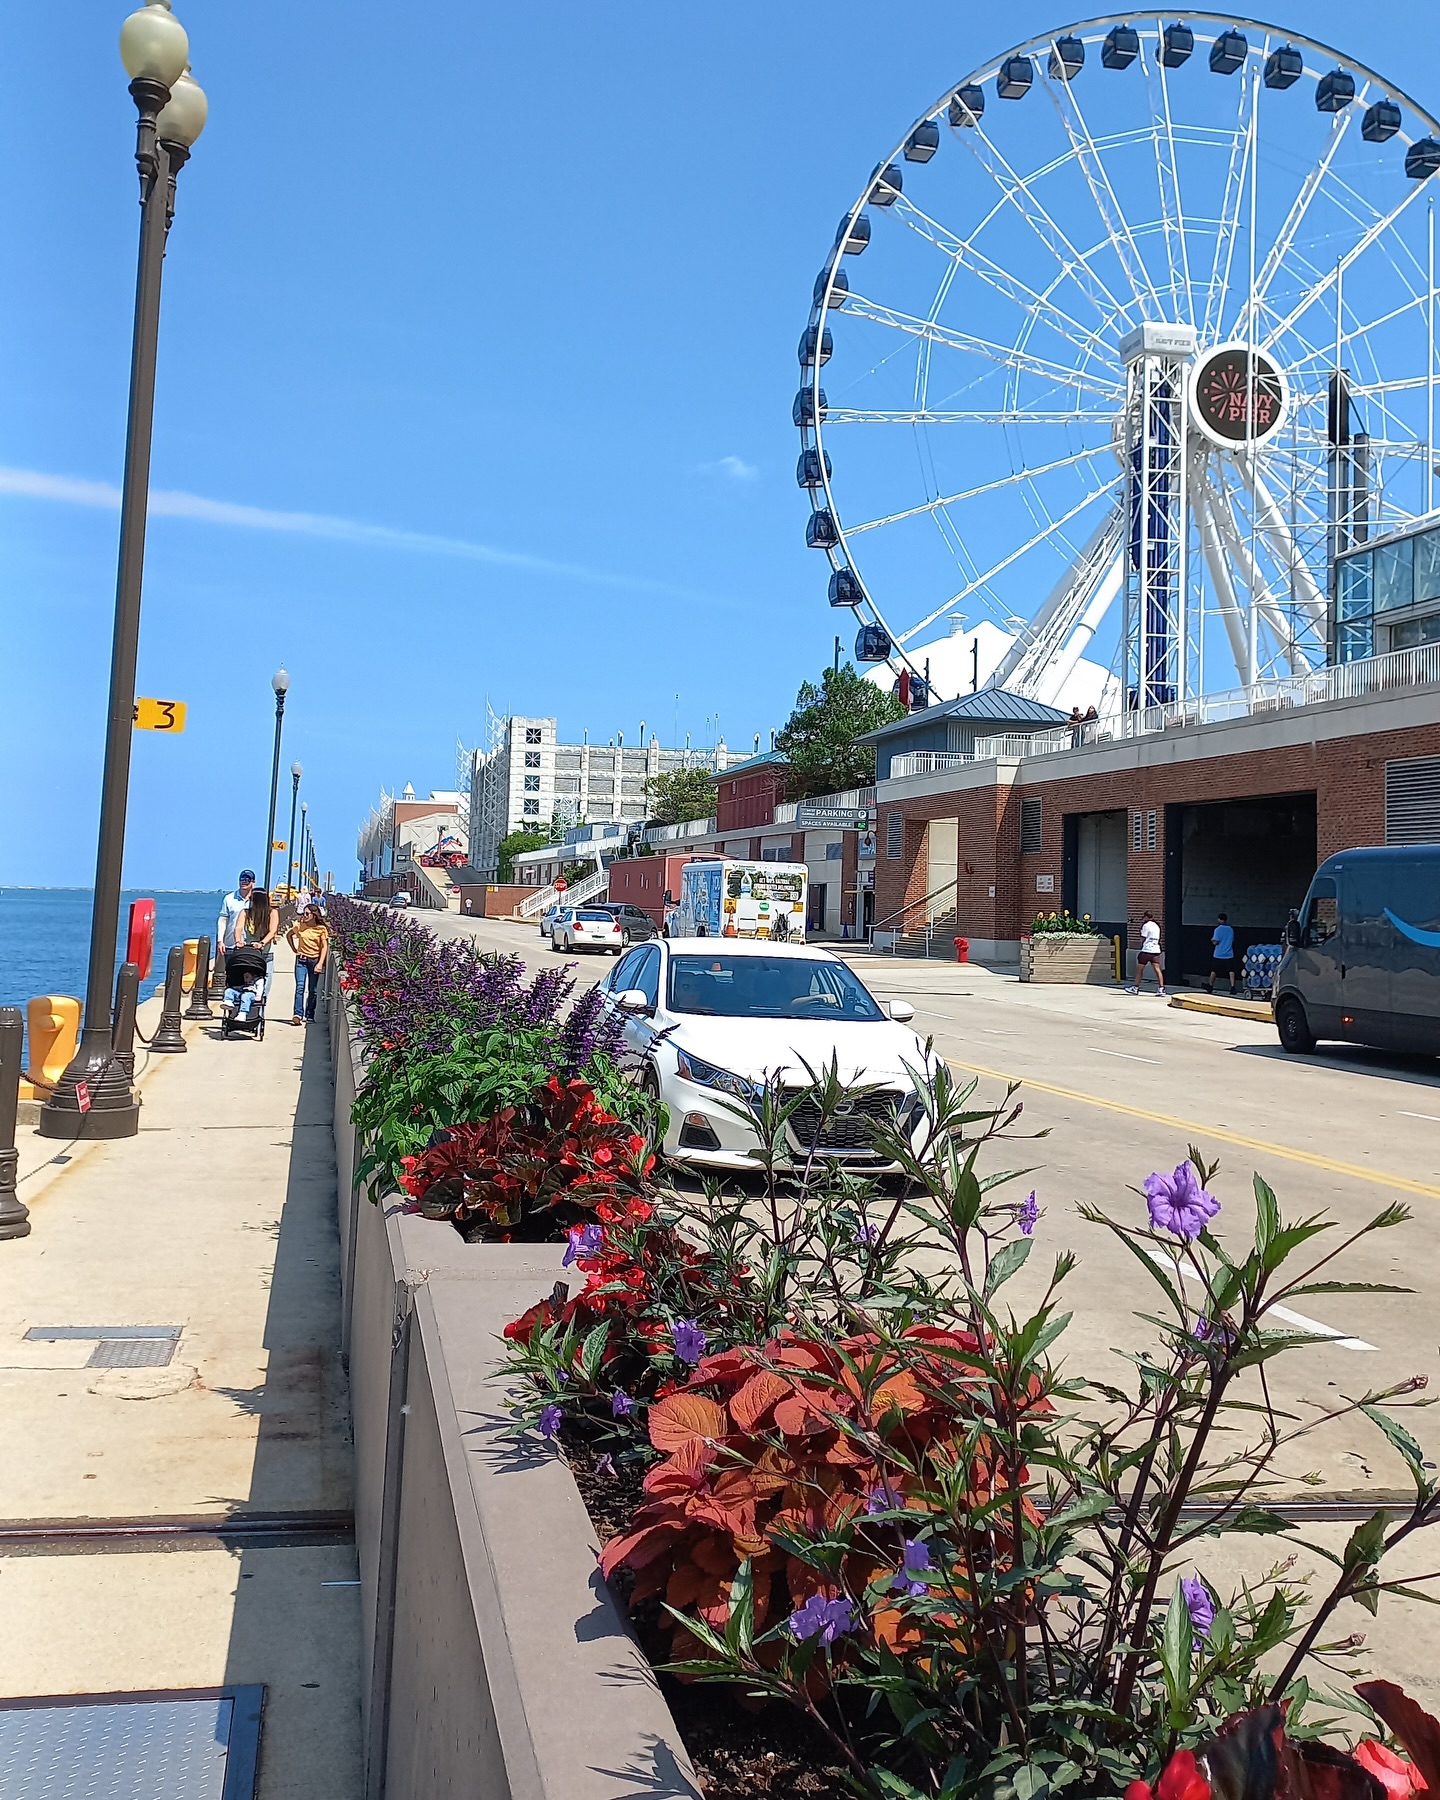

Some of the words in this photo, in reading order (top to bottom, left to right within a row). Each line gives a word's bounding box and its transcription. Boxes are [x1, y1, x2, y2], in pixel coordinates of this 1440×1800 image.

[1229, 392, 1273, 409] NAVY
[154, 701, 176, 729] 3
[815, 809, 853, 818] PARKING
[277, 841, 284, 850] 4
